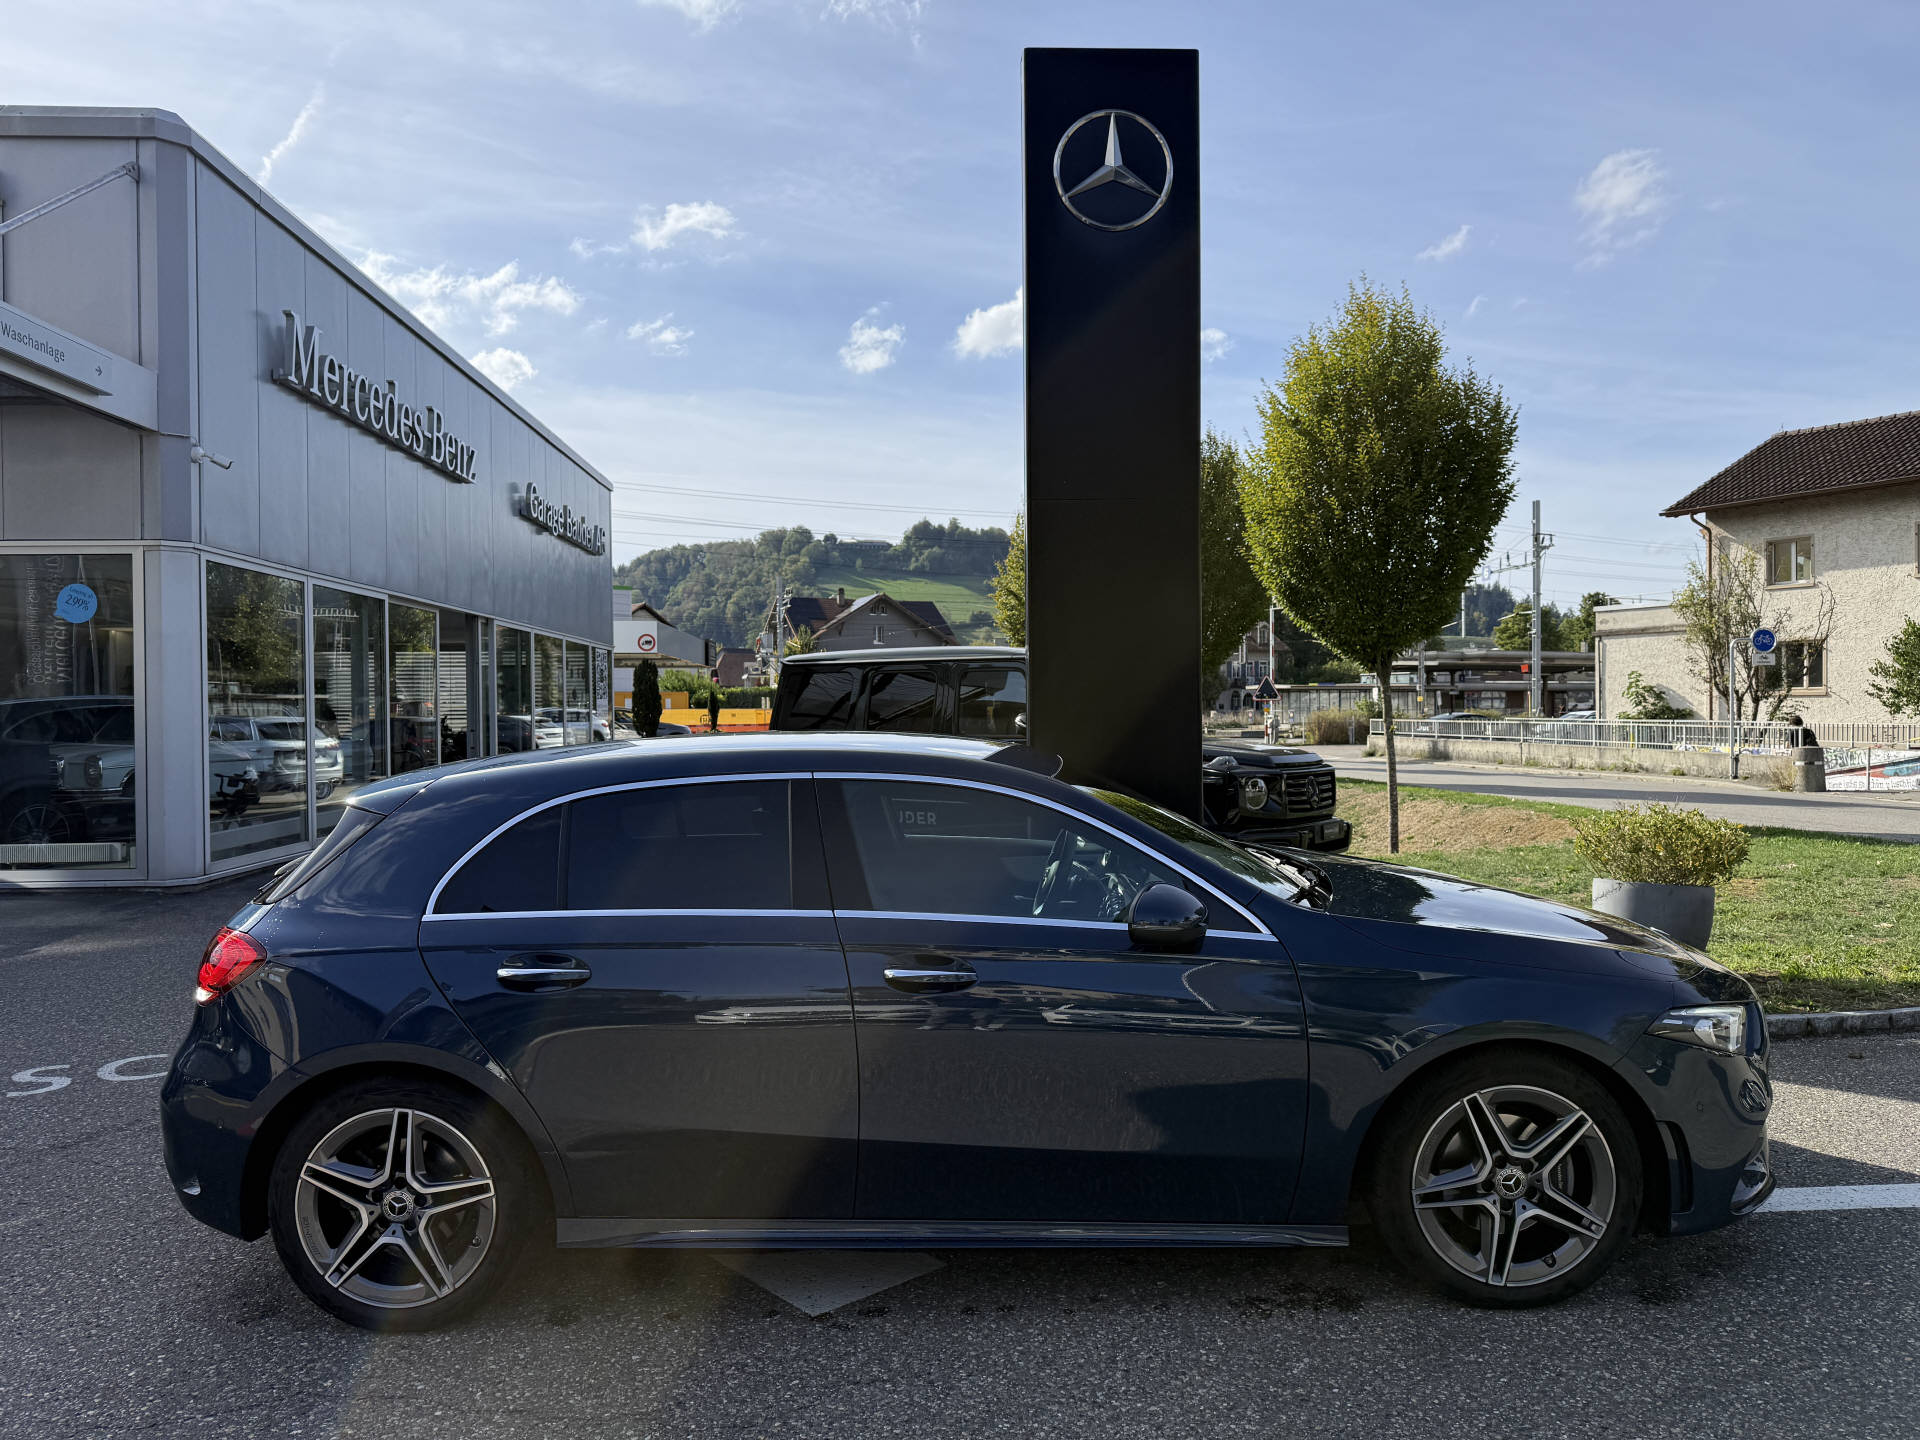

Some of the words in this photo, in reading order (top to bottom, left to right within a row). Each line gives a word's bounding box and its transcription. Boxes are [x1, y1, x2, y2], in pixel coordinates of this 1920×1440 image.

[0, 320, 65, 363] Waschanlage
[282, 309, 477, 484] Mercedes-Benz
[528, 482, 564, 536] Garage
